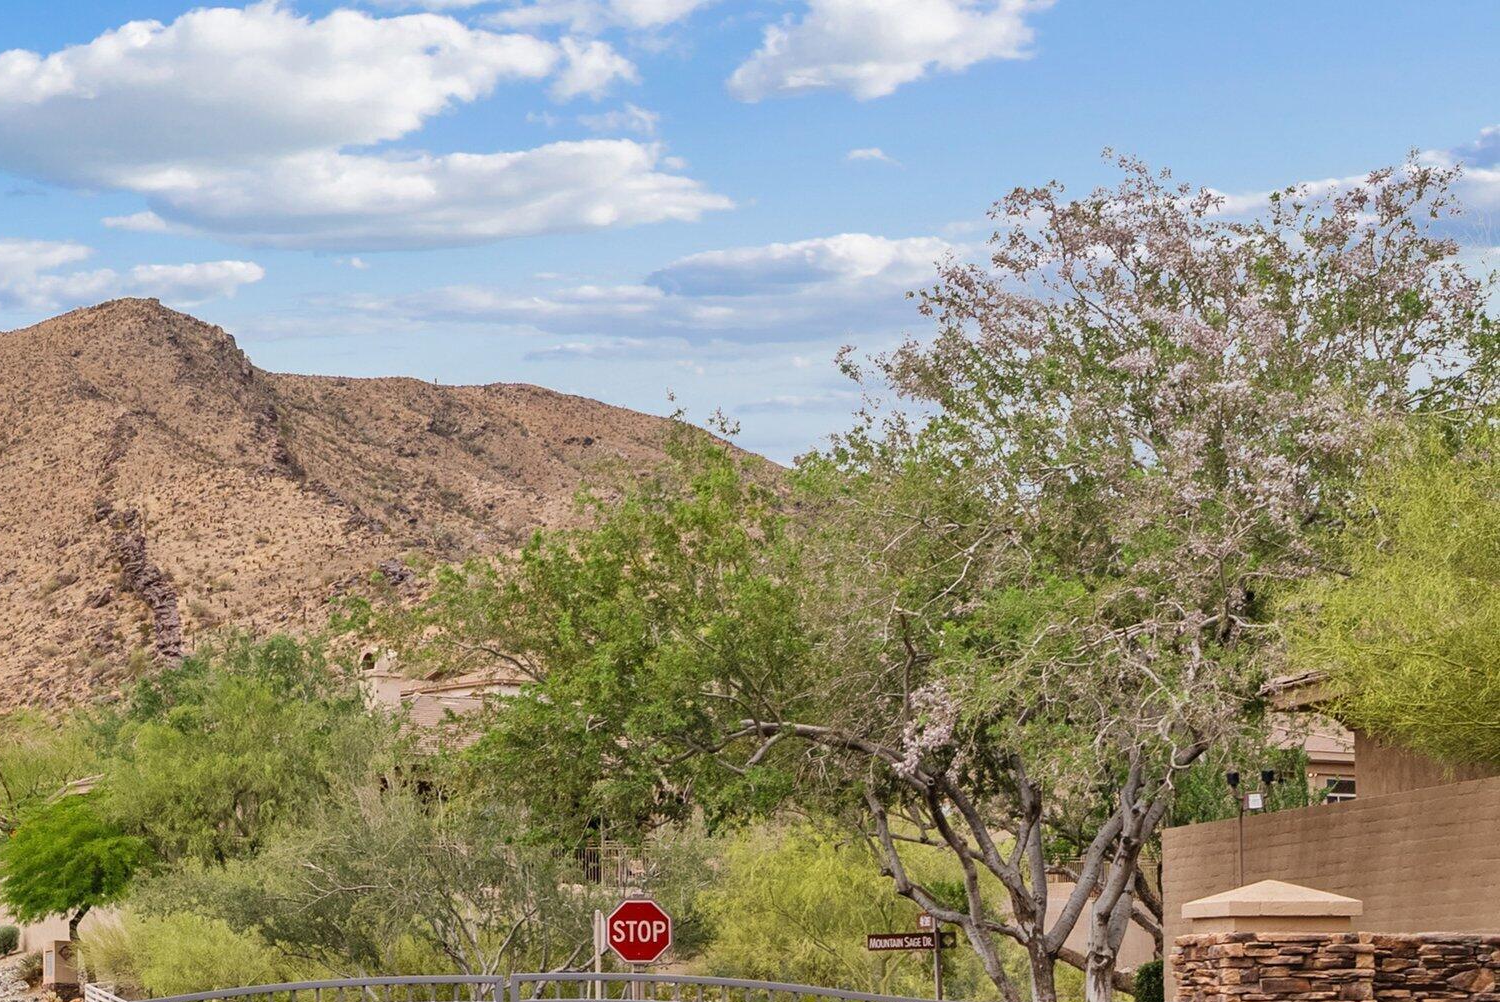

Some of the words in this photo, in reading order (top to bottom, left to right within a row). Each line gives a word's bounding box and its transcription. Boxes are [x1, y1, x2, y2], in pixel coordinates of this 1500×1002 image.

[612, 920, 667, 943] STOP
[869, 938, 903, 949] MOUNTAIN
[904, 936, 922, 948] SAGE
